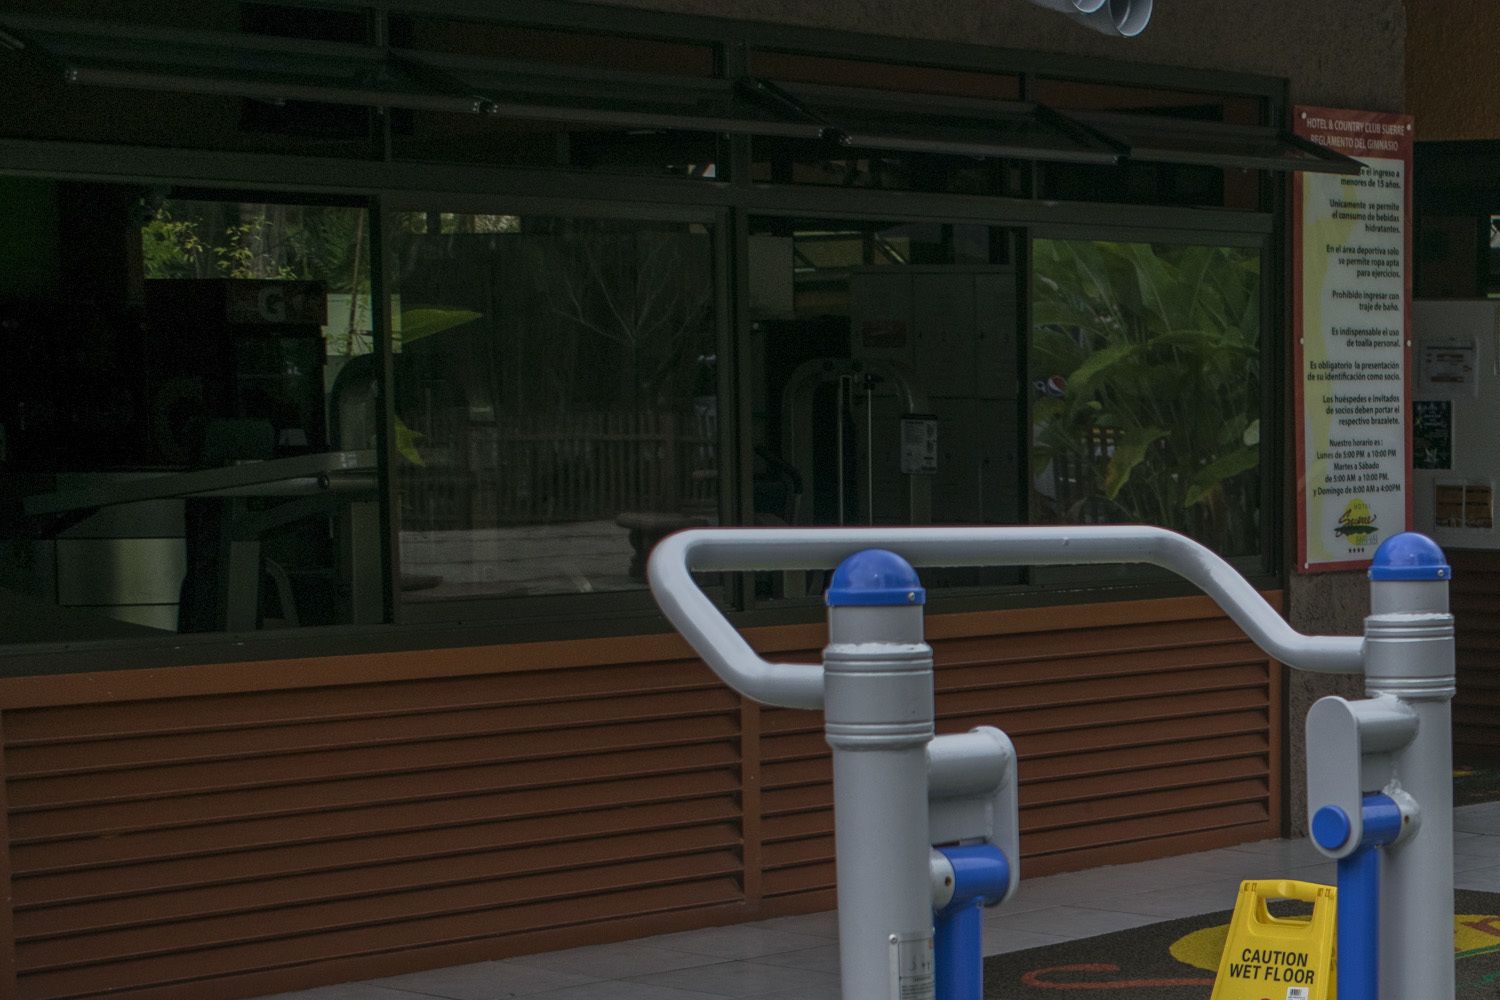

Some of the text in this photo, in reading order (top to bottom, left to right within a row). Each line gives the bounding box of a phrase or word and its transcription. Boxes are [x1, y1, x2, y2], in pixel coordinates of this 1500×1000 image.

[1307, 118, 1404, 136] HOTEL & COUNTRY CLUB SUERRE
[1355, 140, 1366, 149] DEL
[1367, 141, 1398, 151] GIMNASIO
[1366, 167, 1371, 175] el
[1373, 169, 1394, 179] ingreso
[1368, 179, 1375, 187] de
[1377, 180, 1384, 188] 15
[1385, 181, 1401, 189] años.
[1330, 199, 1366, 210] Unicamente
[1376, 202, 1399, 213] permite
[1332, 211, 1338, 219] el
[1367, 212, 1375, 221] de
[1376, 213, 1399, 222] bebidas
[1365, 225, 1400, 233] hidratantes.
[1327, 244, 1399, 256] En el área deportiva solo
[1347, 258, 1370, 267] permite
[1371, 260, 1384, 268] ropa
[1386, 260, 1399, 268] apta
[1357, 270, 1400, 279] para ejercicios.
[1332, 290, 1362, 300] Prohibido
[1363, 291, 1387, 302] ingresar
[1359, 303, 1399, 313] traje de baño.
[1332, 327, 1338, 336] Es
[1340, 327, 1380, 339] indispensable
[1382, 328, 1388, 336] el
[1356, 339, 1372, 347] toalla
[1374, 339, 1400, 349] personal.
[1310, 361, 1399, 371] Es obligatorio la presentación
[1323, 395, 1333, 403] Los
[1373, 395, 1399, 403] invitados
[1335, 406, 1353, 414] socios
[1355, 406, 1373, 414] deben
[1375, 406, 1393, 416] portar
[1339, 416, 1400, 428] respectivo brazalete.
[1353, 438, 1373, 446] horario
[1317, 451, 1333, 459] Lunes
[1335, 451, 1341, 459] de
[1356, 450, 1365, 458] PM
[1372, 450, 1386, 458] 10:00
[1388, 449, 1396, 457] PM
[1325, 475, 1332, 483] de
[1334, 475, 1345, 483] 5:00
[1347, 474, 1356, 482] AM
[1363, 473, 1377, 481] 10:00
[1318, 486, 1343, 496] Domingo
[1345, 486, 1352, 494] de
[1353, 485, 1365, 494] 8:00
[1242, 948, 1308, 968] CAUTION
[1229, 963, 1315, 985] WET FLOOR
